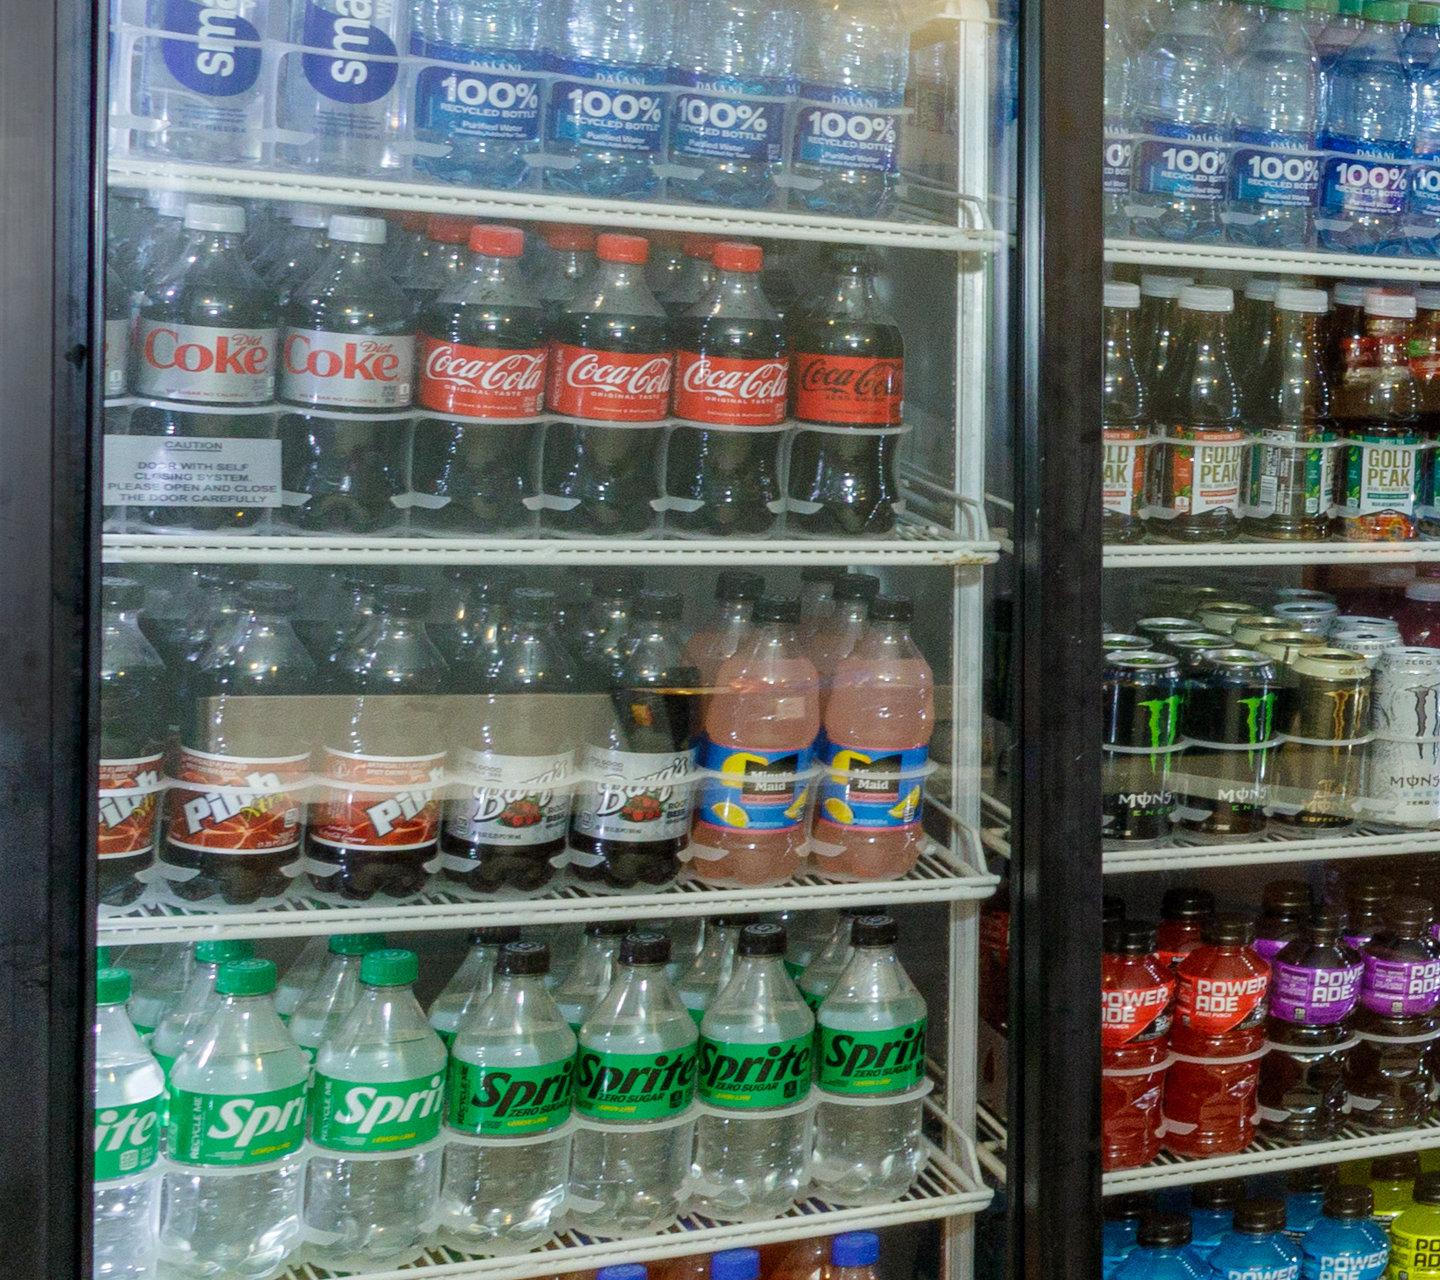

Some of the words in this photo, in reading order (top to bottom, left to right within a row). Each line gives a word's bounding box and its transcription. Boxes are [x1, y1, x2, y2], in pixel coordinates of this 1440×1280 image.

[441, 75, 538, 109] 100%
[679, 98, 768, 132] 100%
[144, 328, 269, 375] Coke
[425, 346, 543, 391] Coca-Cola
[165, 441, 223, 449] CAUTION
[1368, 448, 1411, 468] GOLD
[1367, 468, 1411, 488] PEAK
[192, 495, 266, 503] CAREFULLY
[754, 780, 787, 793] Maid
[856, 778, 889, 791] Maid
[1198, 977, 1268, 996] POWER
[1197, 995, 1239, 1013] ADE
[578, 1043, 696, 1096] Sprite
[700, 1039, 809, 1084] Sprite
[597, 1093, 627, 1103] ZERO
[630, 1093, 665, 1103] SUGAR
